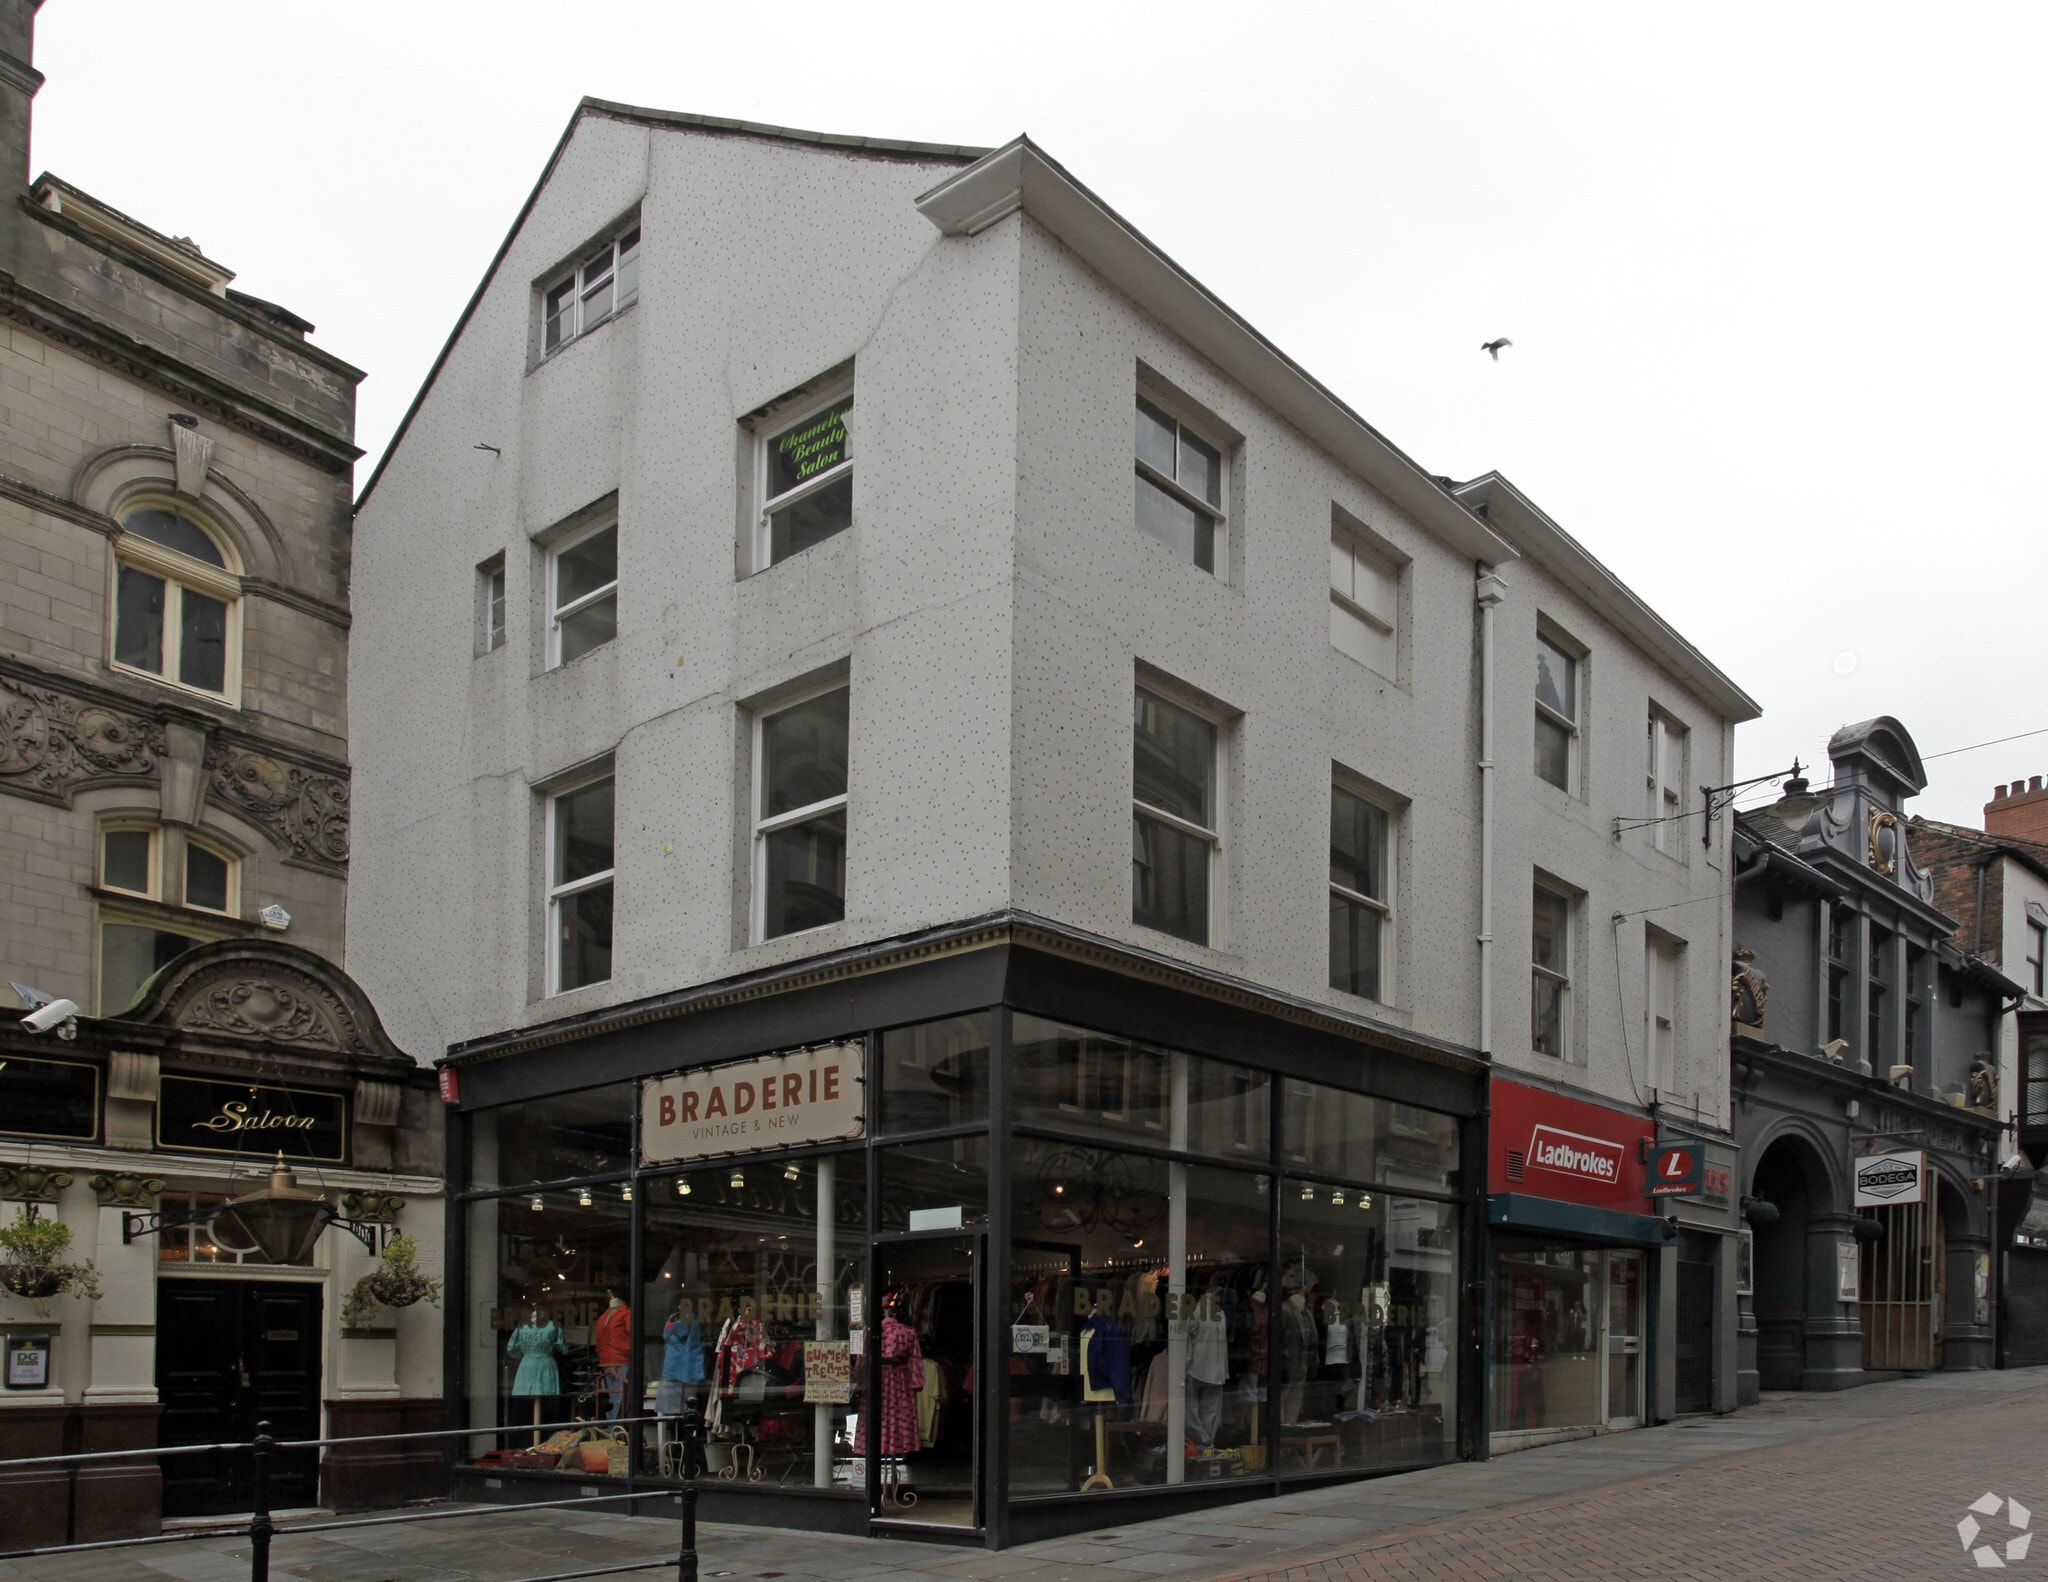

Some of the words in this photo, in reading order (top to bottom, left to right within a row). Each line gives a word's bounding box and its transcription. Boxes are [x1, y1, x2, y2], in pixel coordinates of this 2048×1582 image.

[779, 408, 850, 453] Chamele
[792, 428, 844, 463] Beauty
[797, 452, 837, 479] Salon
[659, 1065, 840, 1127] BRADERIE
[192, 1101, 315, 1132] Saloon
[692, 1121, 748, 1140] VINTAGE
[753, 1119, 761, 1131] &
[768, 1113, 800, 1131] NEW
[1536, 1140, 1615, 1177] Ladbrokes
[1666, 1153, 1682, 1176] L
[1652, 1186, 1687, 1194] Ladbrokes
[1860, 1172, 1915, 1186] BODEGA
[679, 1292, 823, 1324] BRADERIE
[1073, 1286, 1223, 1322] BRADERIE
[17, 1353, 38, 1361] DG
[805, 1349, 849, 1363] SUMMER
[805, 1363, 849, 1378] TREATS
